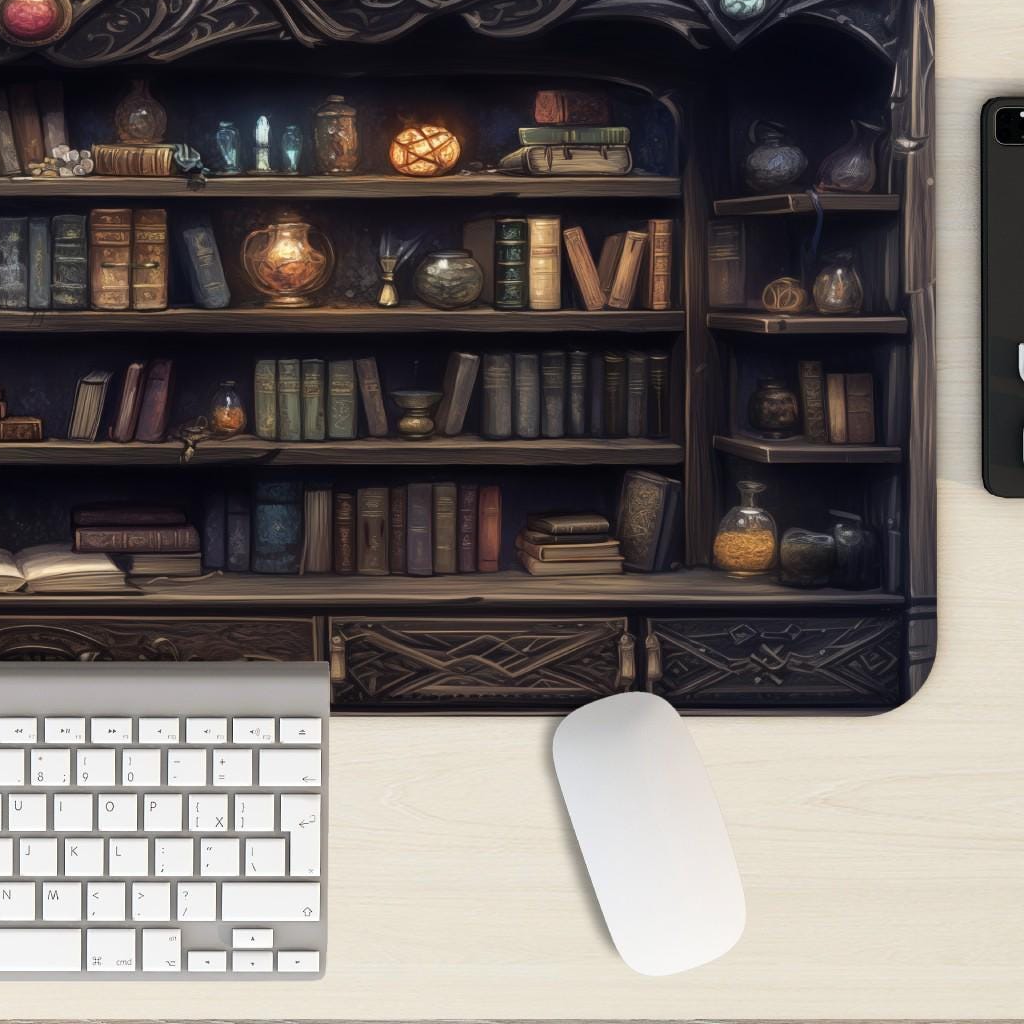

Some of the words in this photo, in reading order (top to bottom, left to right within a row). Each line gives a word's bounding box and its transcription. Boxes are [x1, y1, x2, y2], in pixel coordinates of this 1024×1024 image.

[36, 771, 44, 783] 8
[82, 771, 89, 782] 9
[14, 799, 23, 812] U
[105, 800, 115, 813] O
[149, 801, 157, 812] P
[215, 816, 224, 828] X
[24, 844, 31, 856] J
[70, 845, 79, 857] K
[115, 845, 122, 857] L
[2, 889, 12, 900] N
[47, 889, 60, 901] M
[115, 959, 133, 967] cmd
